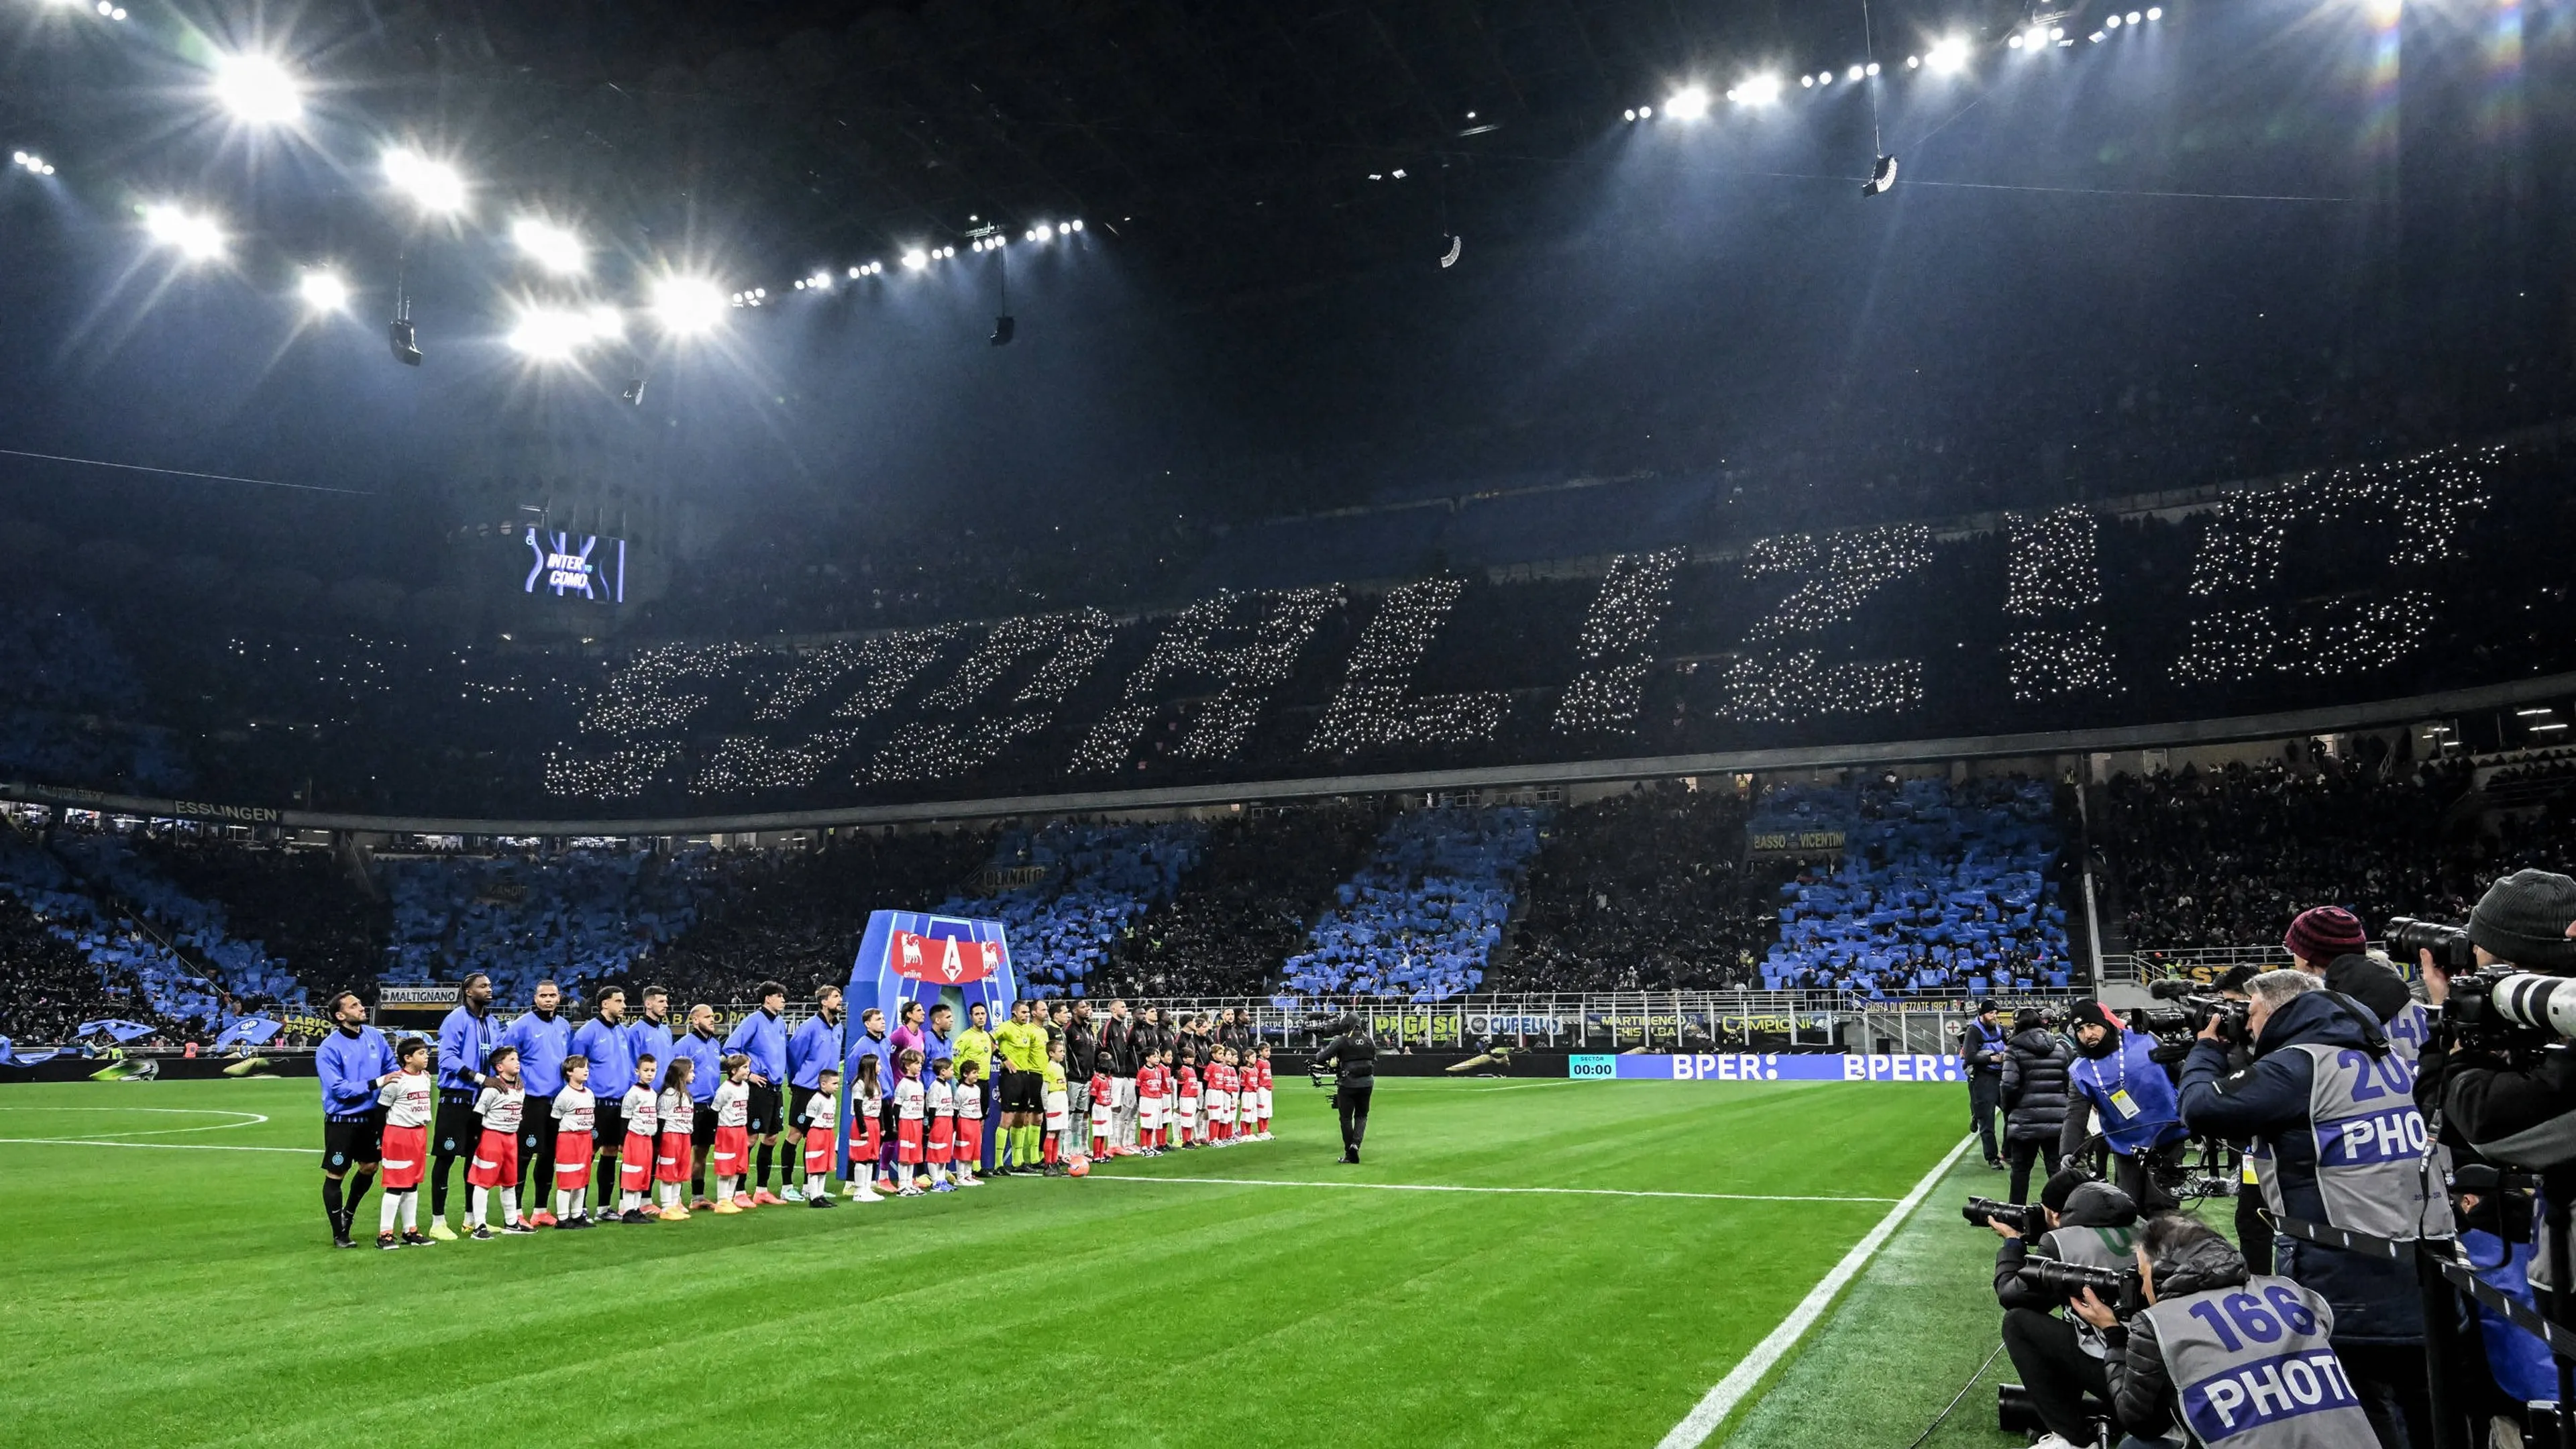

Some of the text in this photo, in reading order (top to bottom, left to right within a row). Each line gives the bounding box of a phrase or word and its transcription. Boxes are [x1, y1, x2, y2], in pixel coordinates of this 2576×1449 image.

[547, 553, 585, 571] INTER
[549, 570, 588, 590] COMO
[175, 800, 277, 822] ESSLINGEN
[1754, 835, 1786, 849] BASSO
[390, 991, 455, 1002] MALTIGNANO
[1899, 1001, 1929, 1012] MEZZATE
[1931, 1001, 1947, 1012] 1987
[1574, 1065, 1612, 1075] 00:00
[2188, 1286, 2316, 1352] 166
